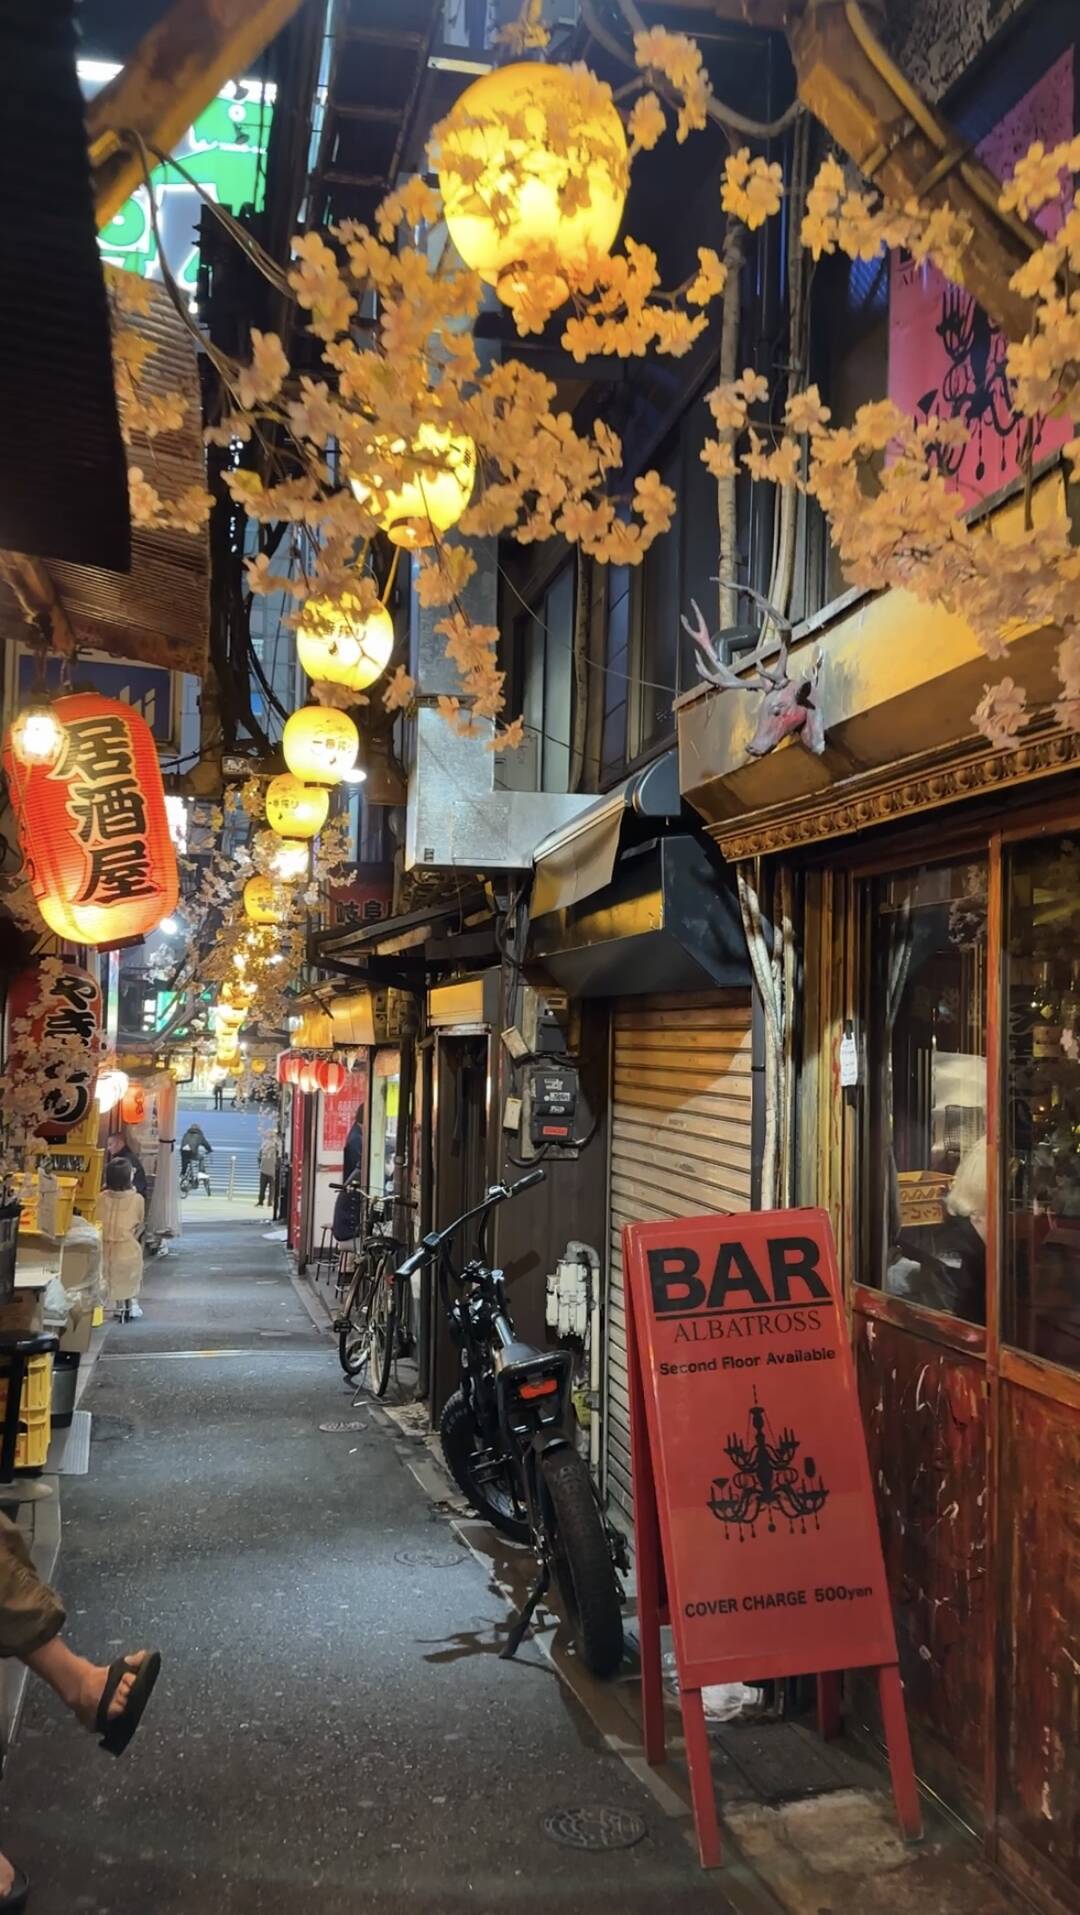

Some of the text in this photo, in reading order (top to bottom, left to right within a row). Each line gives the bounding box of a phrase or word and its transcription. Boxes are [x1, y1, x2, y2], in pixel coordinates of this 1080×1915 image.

[55, 715, 158, 904] 居酒屋
[336, 900, 393, 924] 岐阜
[647, 1236, 832, 1313] BAR
[673, 1310, 823, 1343] ALBATROSS
[660, 1347, 836, 1376] Second Floor Available
[684, 1584, 874, 1619] COVER CHARGE 500yen
